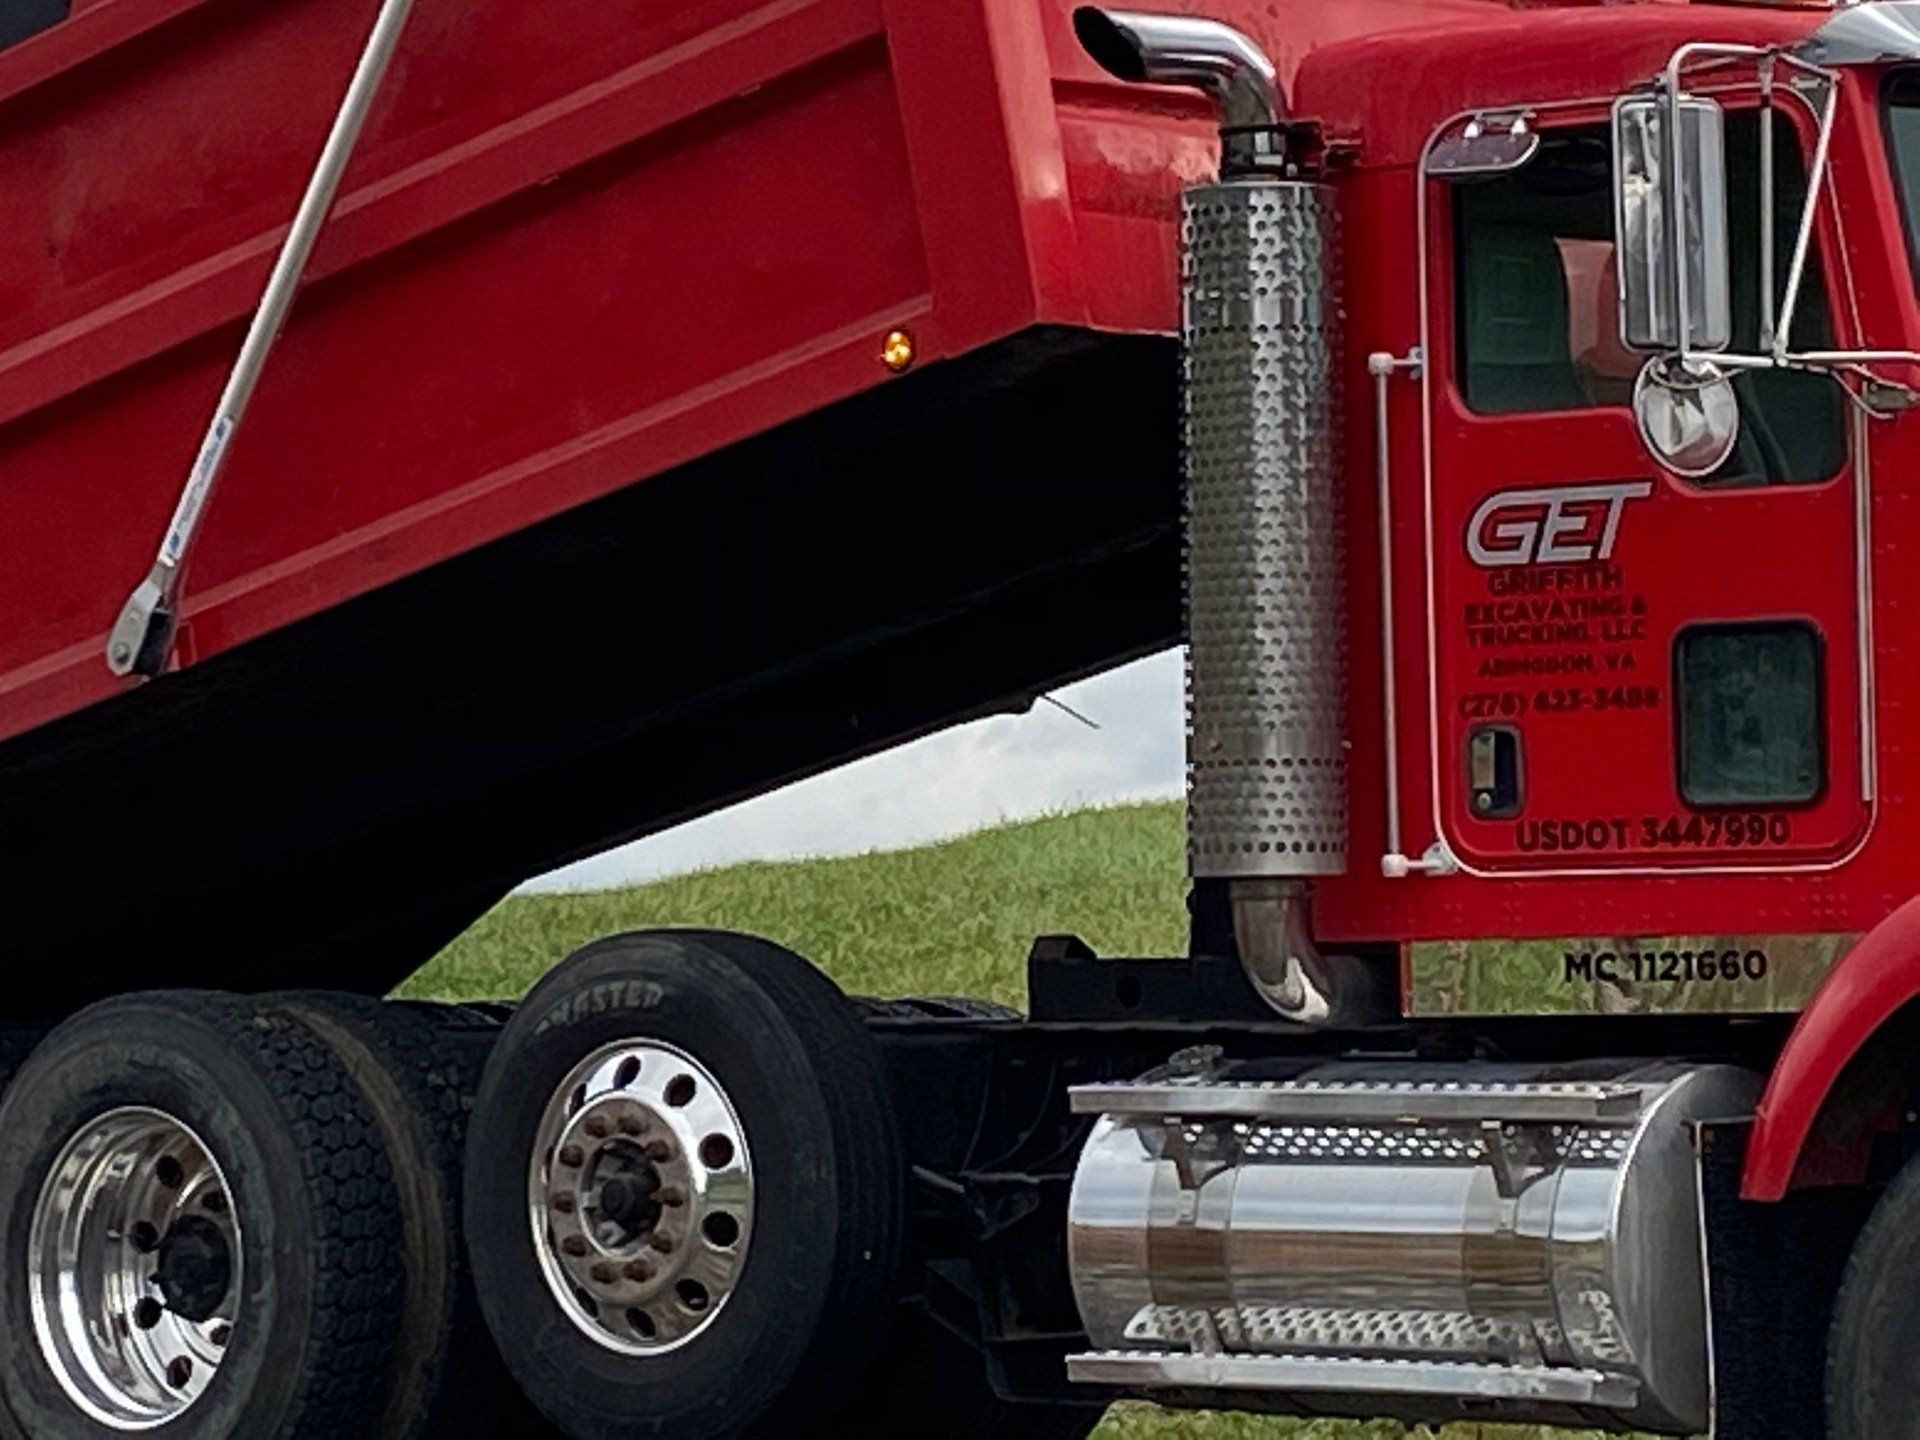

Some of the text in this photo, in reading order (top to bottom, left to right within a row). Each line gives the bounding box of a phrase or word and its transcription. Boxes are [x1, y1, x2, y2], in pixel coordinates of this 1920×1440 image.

[1465, 481, 1653, 567] GET
[1488, 564, 1623, 596] GRIFFITH
[1465, 595, 1623, 624] EXCAVATING
[1601, 619, 1647, 643] LLC
[1516, 814, 1791, 851] USDOT 3447990
[1564, 950, 1767, 983] MC 1121660
